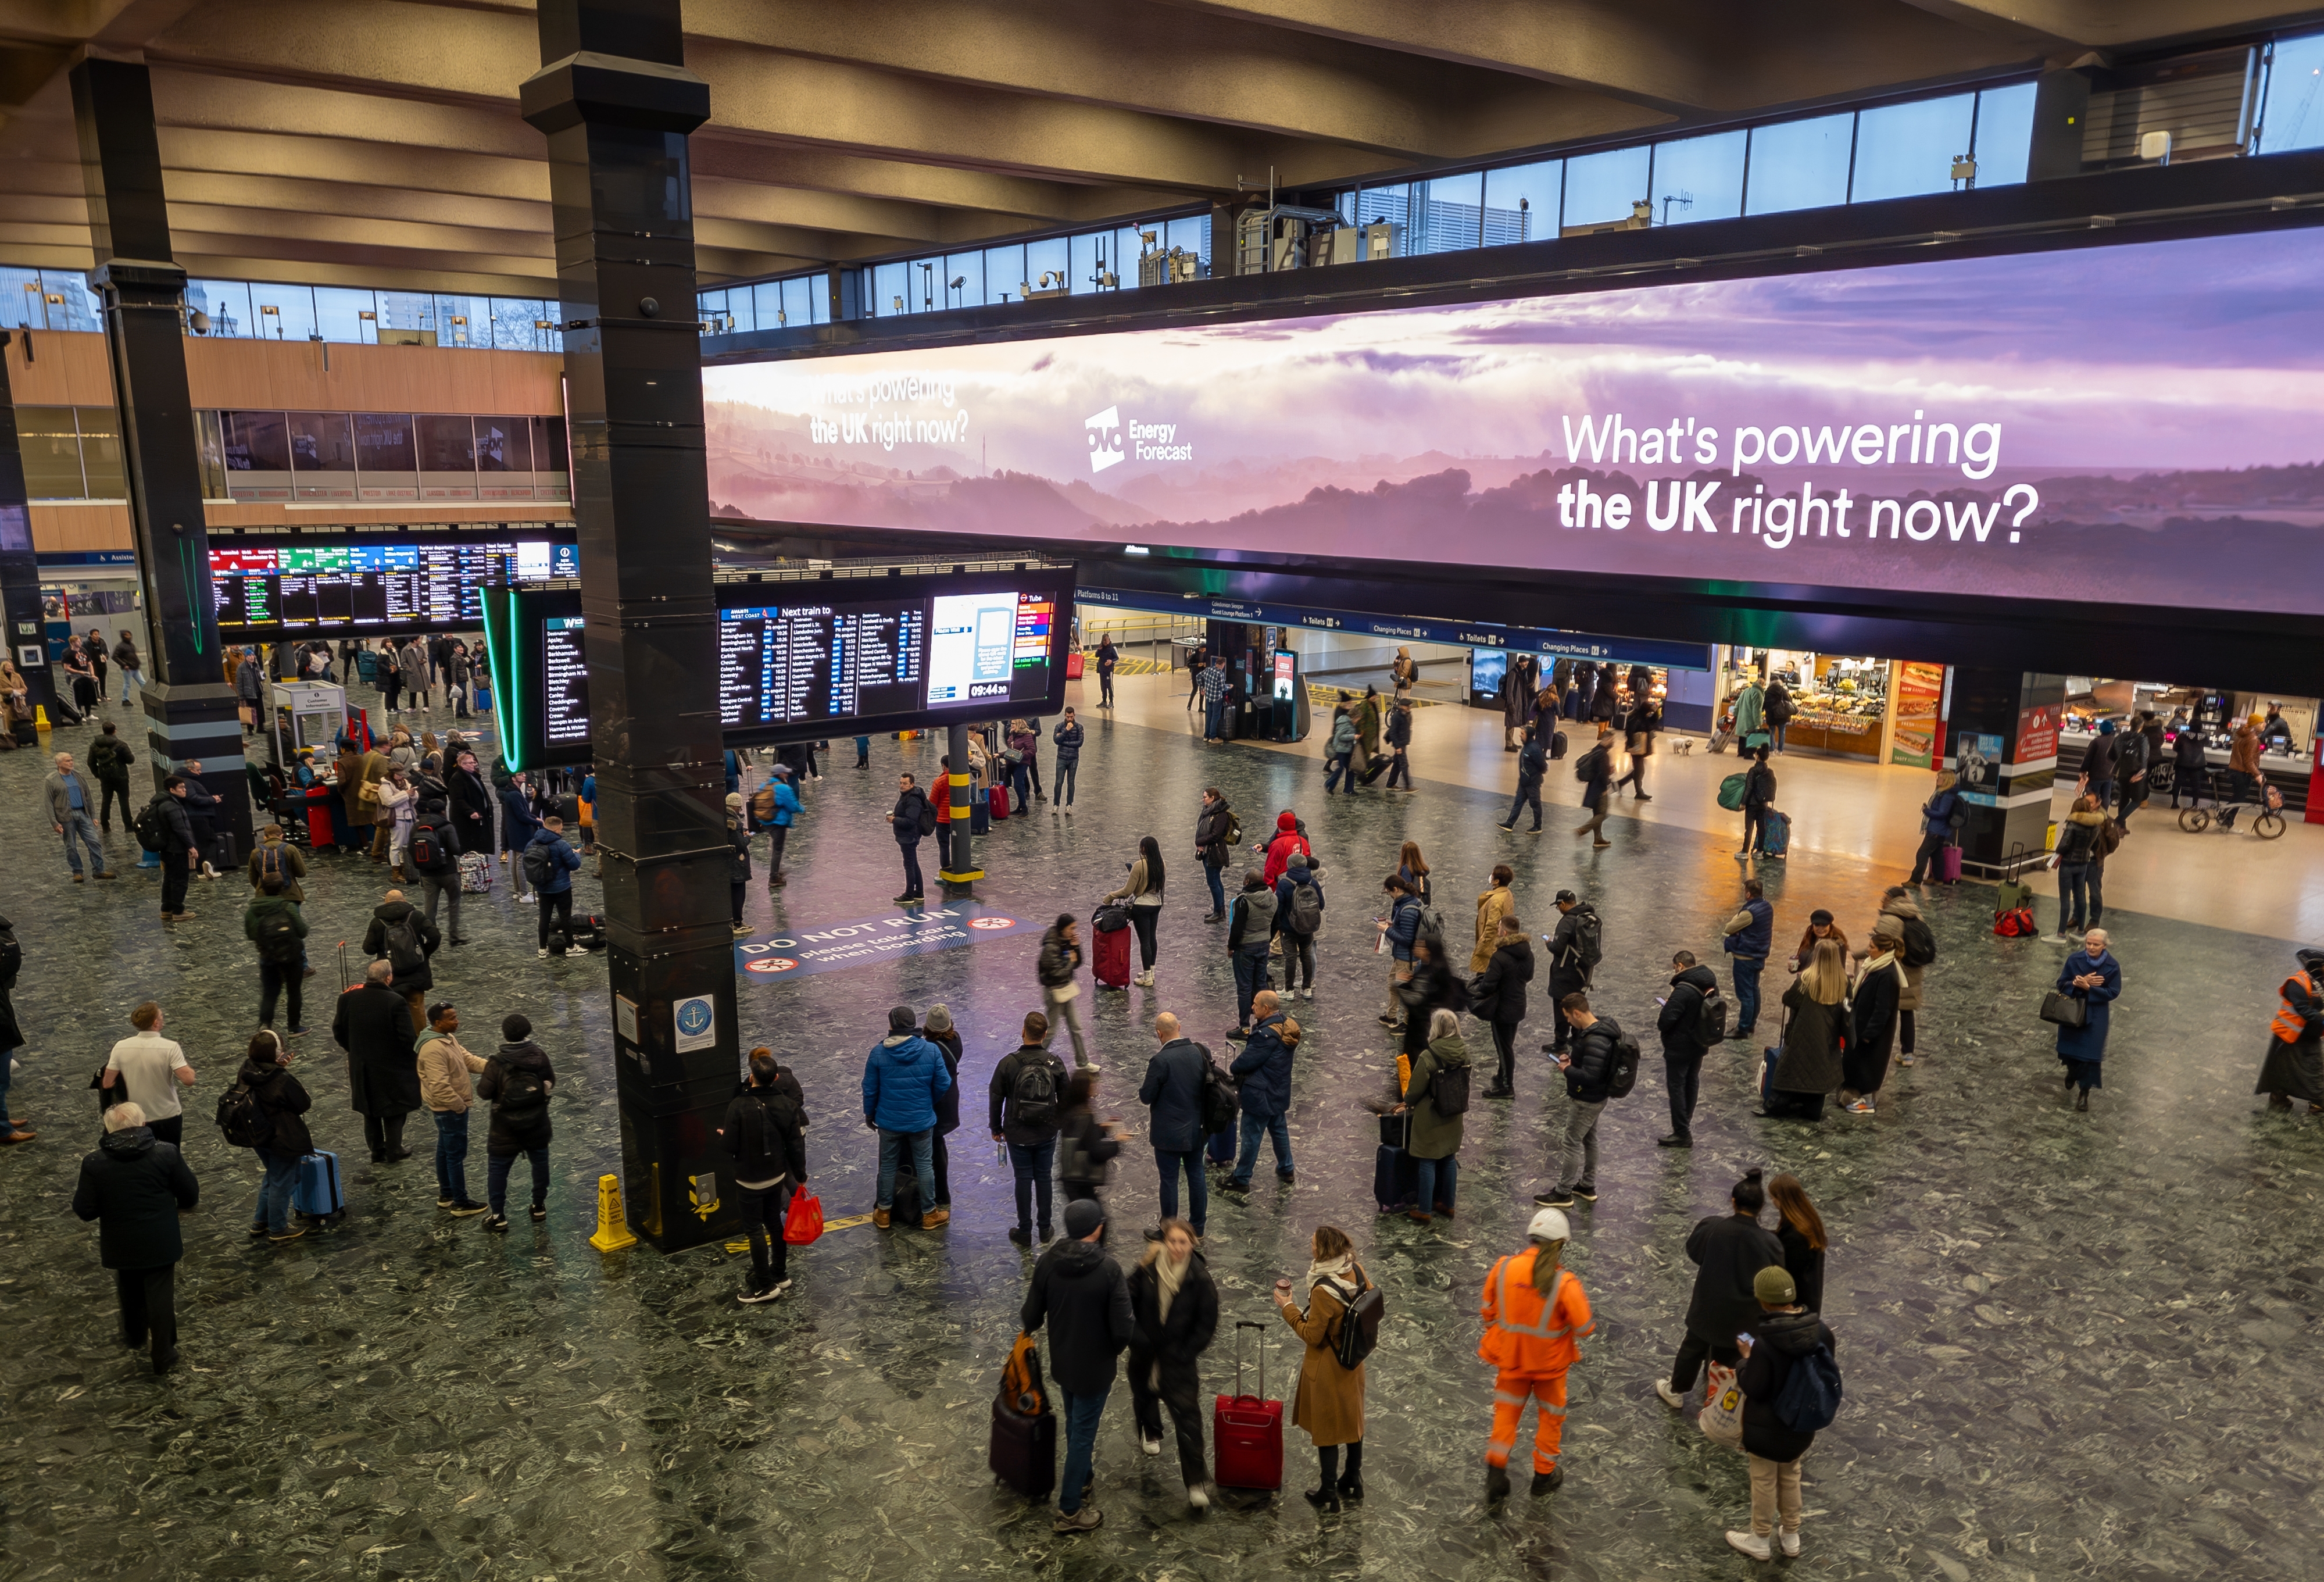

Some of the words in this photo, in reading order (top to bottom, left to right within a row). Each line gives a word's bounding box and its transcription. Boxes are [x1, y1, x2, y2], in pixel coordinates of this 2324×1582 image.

[870, 370, 954, 409] powering
[810, 413, 838, 444] the
[842, 413, 868, 444] UK
[872, 411, 912, 451] right
[917, 409, 968, 443] now?
[1129, 419, 1177, 444] Energy
[1136, 441, 1192, 460] Forecast
[1563, 413, 1718, 465] What's
[1732, 409, 2002, 480] powering
[1557, 479, 1632, 530] the
[1646, 481, 1722, 532] UK
[1732, 481, 1854, 549] right
[1869, 483, 2039, 543] now?
[1078, 590, 1100, 599] Platforms
[782, 608, 801, 617] Next
[802, 606, 821, 615] train
[1309, 617, 1325, 626] Toilets
[1374, 625, 1396, 635] Changing
[1397, 627, 1411, 635] Places
[1467, 634, 1486, 643] Toilets
[1543, 642, 1569, 653] Changing
[1571, 645, 1588, 653] Places
[971, 684, 997, 697] 09:44
[739, 939, 797, 954] DO
[801, 923, 877, 942] NOT
[882, 909, 961, 927] RUN
[799, 942, 866, 959] please
[867, 933, 913, 944] take
[916, 926, 957, 935] care
[816, 948, 875, 962] when
[874, 931, 967, 951] boarding
[699, 1001, 711, 1015] EXPRESS
